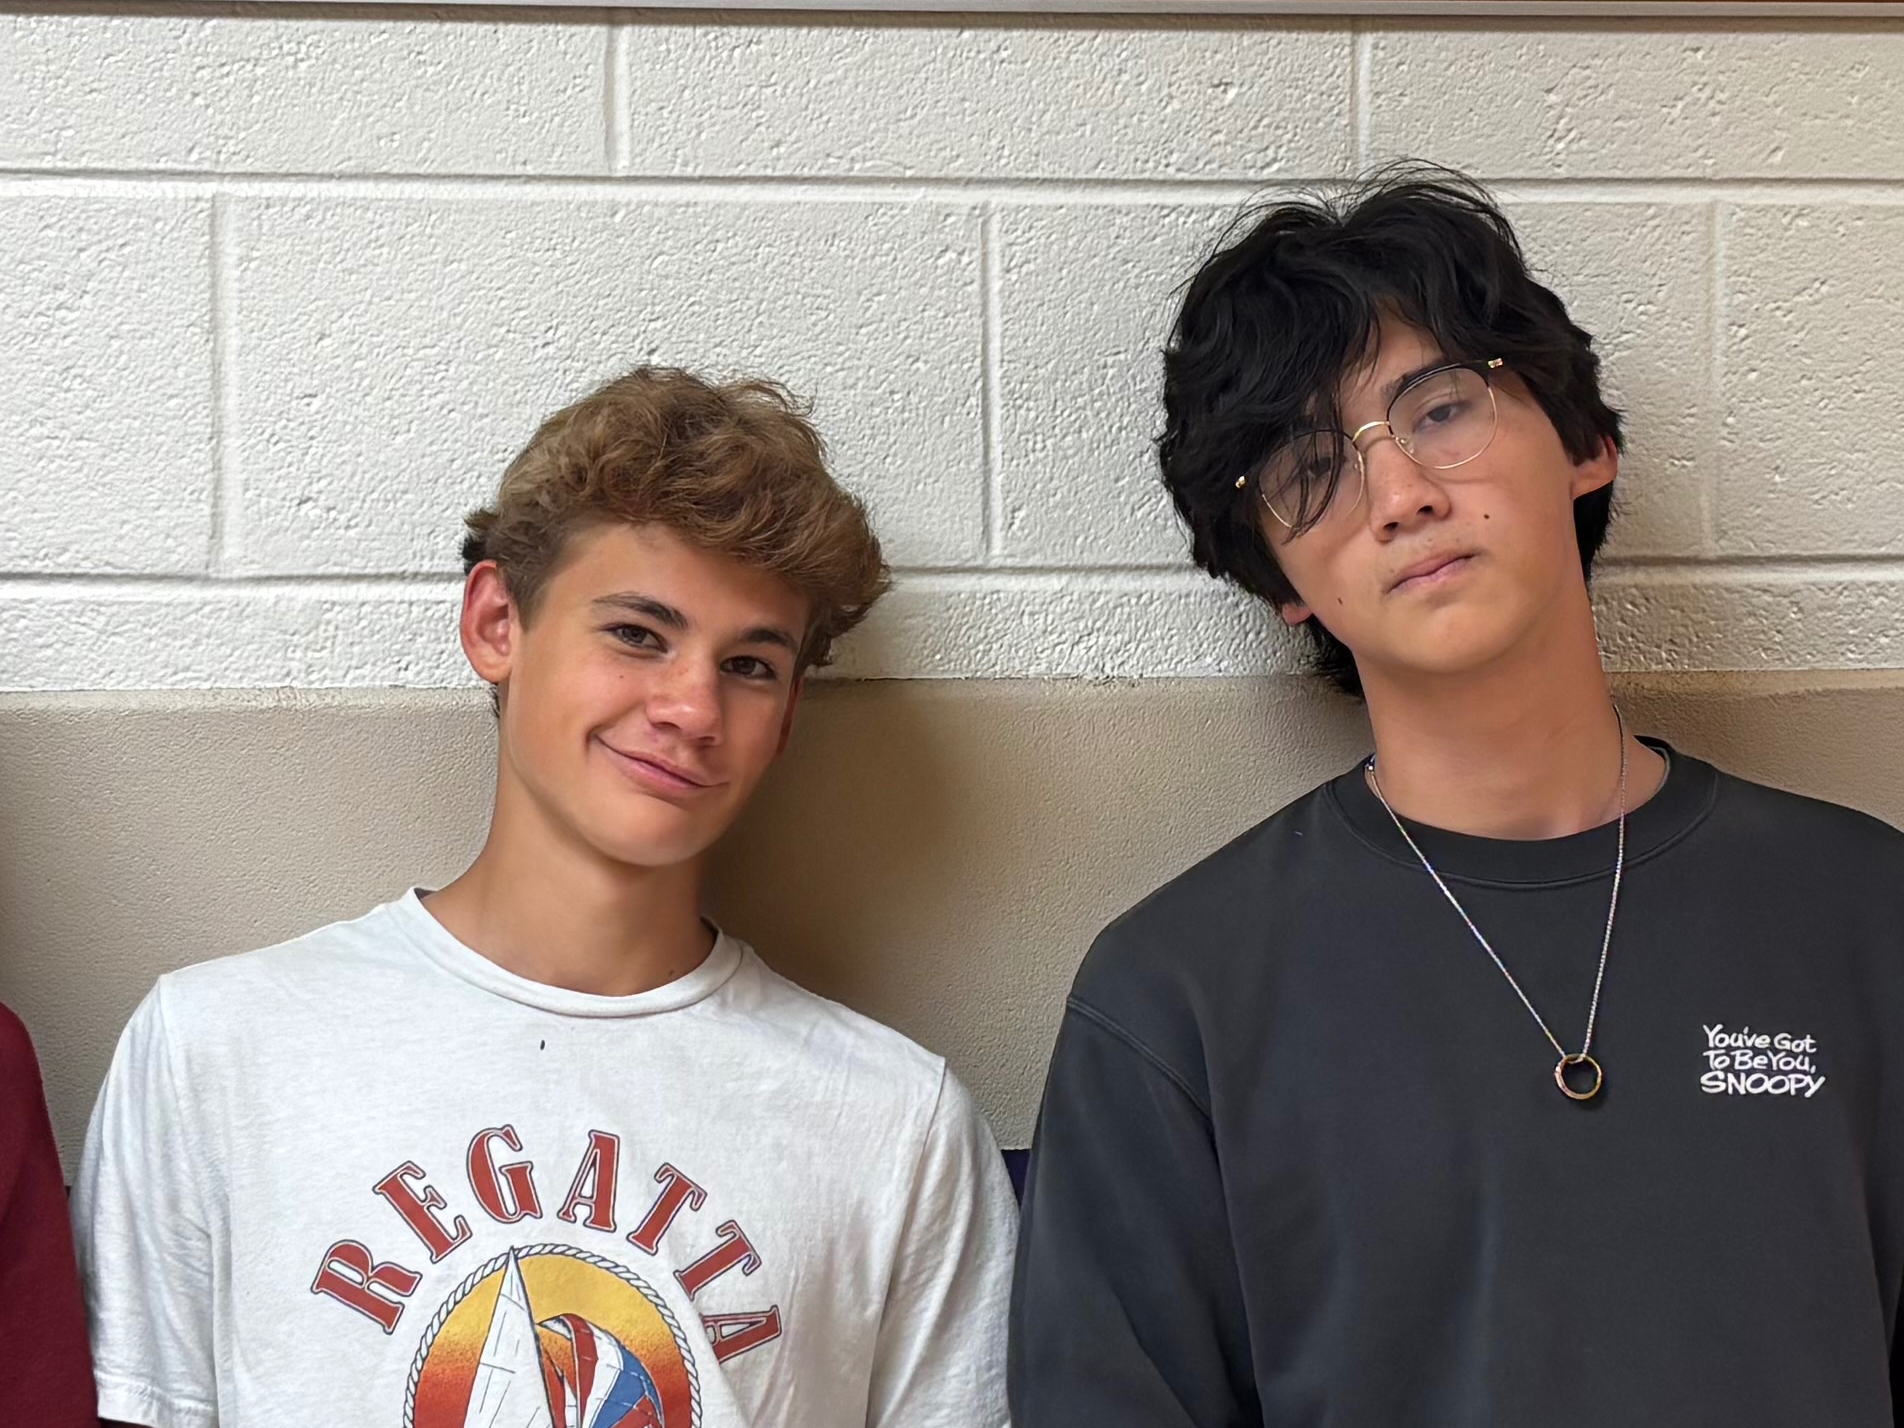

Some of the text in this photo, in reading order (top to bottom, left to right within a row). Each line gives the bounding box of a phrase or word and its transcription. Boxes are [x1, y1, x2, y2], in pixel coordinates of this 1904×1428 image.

[1703, 1024, 1817, 1053] You've Got
[1703, 1049, 1817, 1074] To Be You,
[1700, 1070, 1826, 1098] SNOOPY
[310, 1124, 782, 1365] REGATTA
